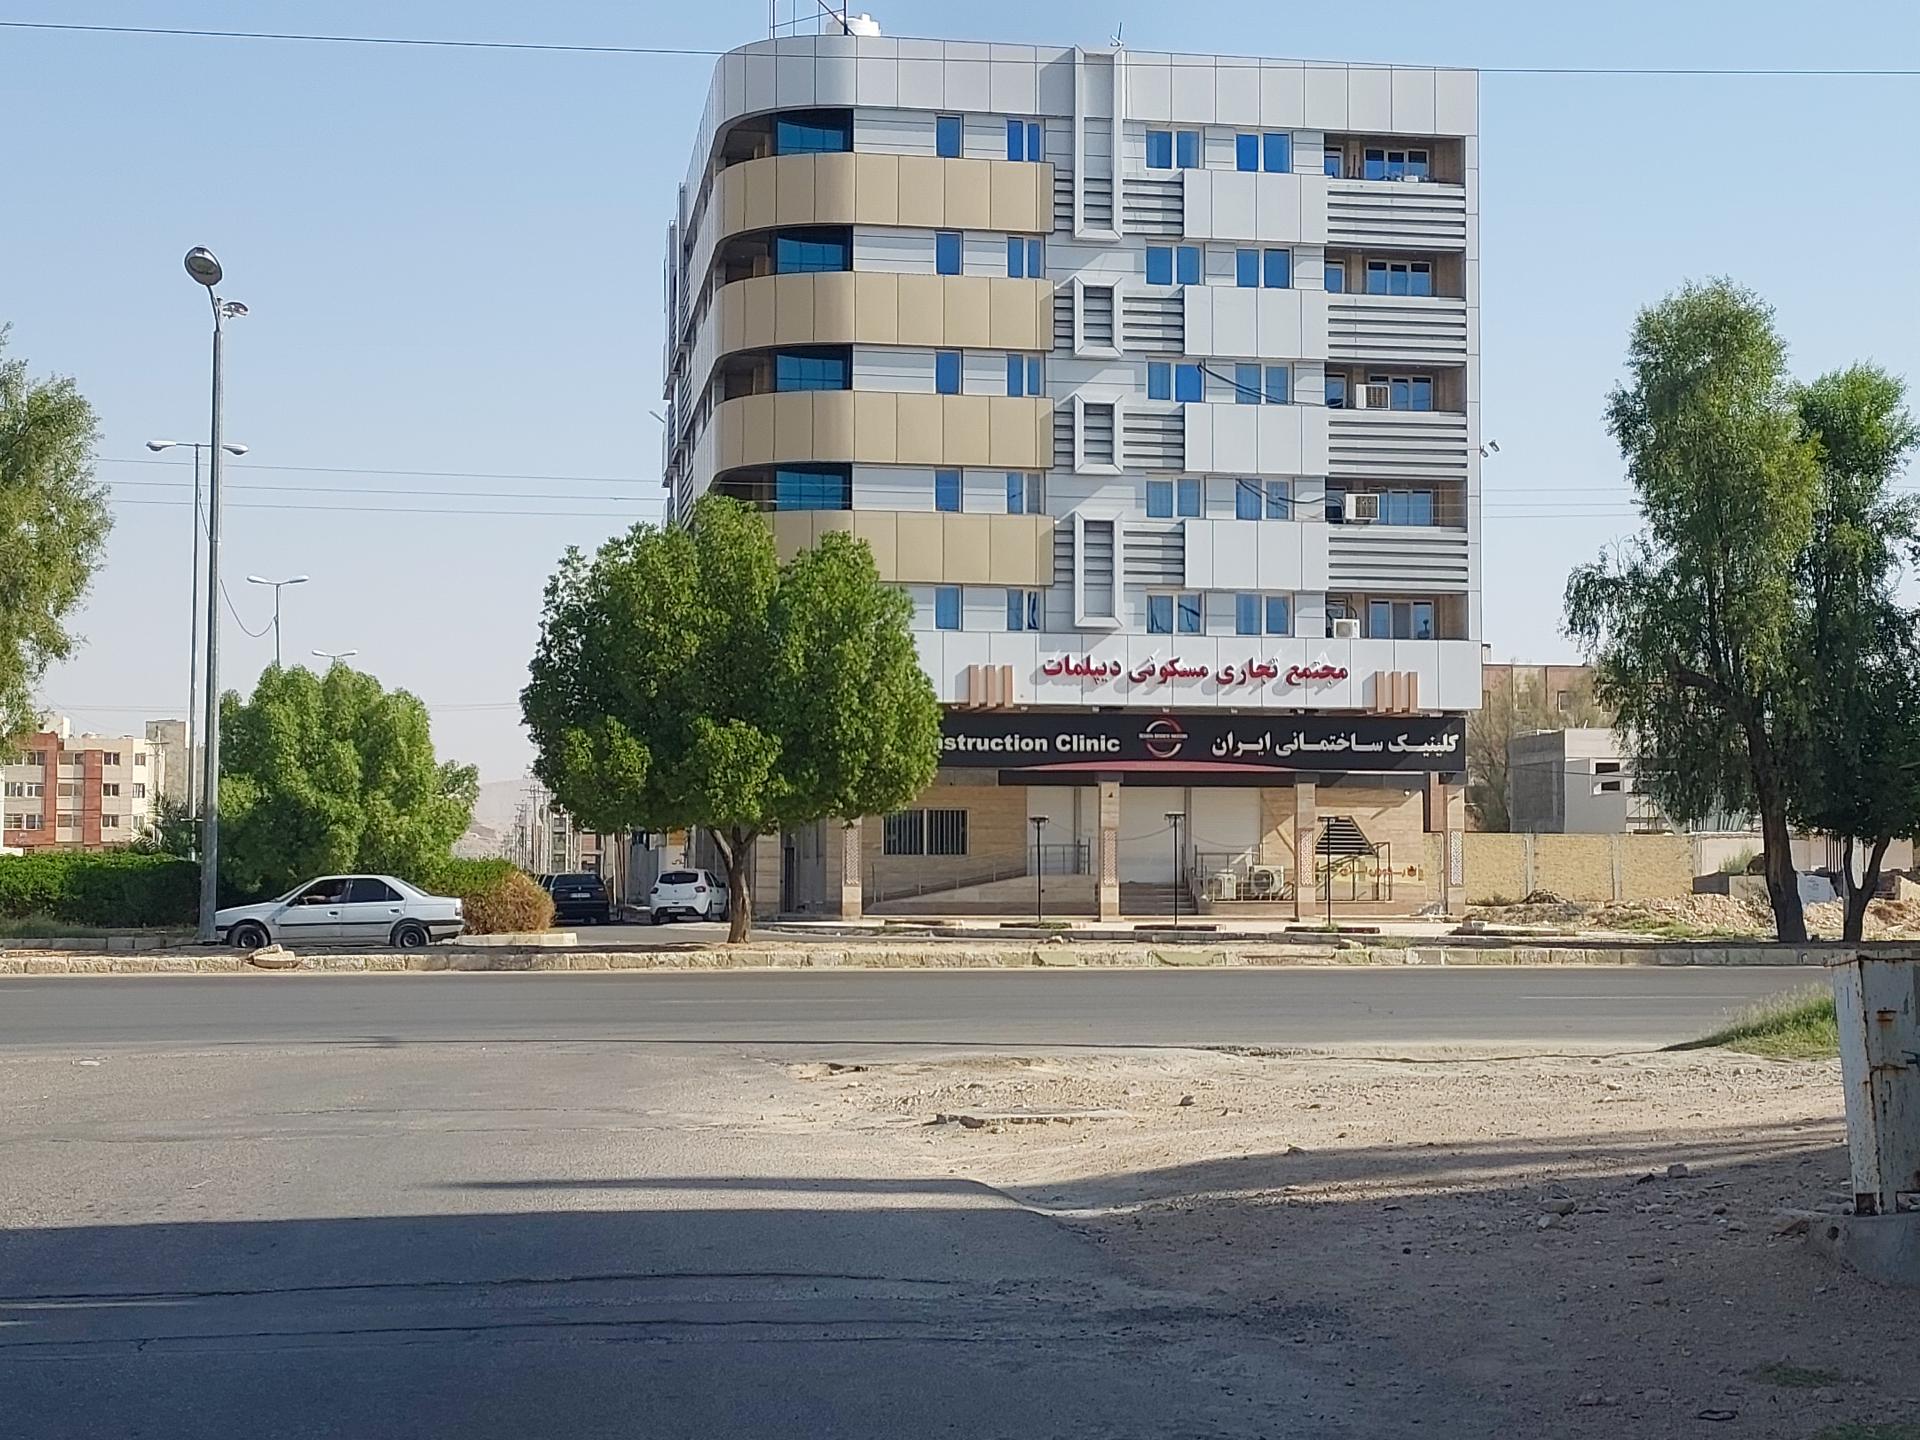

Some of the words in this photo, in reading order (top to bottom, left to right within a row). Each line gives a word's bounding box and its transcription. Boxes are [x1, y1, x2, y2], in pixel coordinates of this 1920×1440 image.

[1043, 654, 1121, 685] دیپلمات
[1129, 656, 1208, 684] مسکونی
[1216, 656, 1278, 685] تجاری
[1286, 661, 1348, 686] مجتمع
[936, 734, 1048, 751] nstruction
[1056, 734, 1120, 752] Clinic
[1211, 730, 1271, 757] ایران
[1275, 731, 1383, 756] ساختمانی
[1388, 733, 1459, 757] کلینیک
